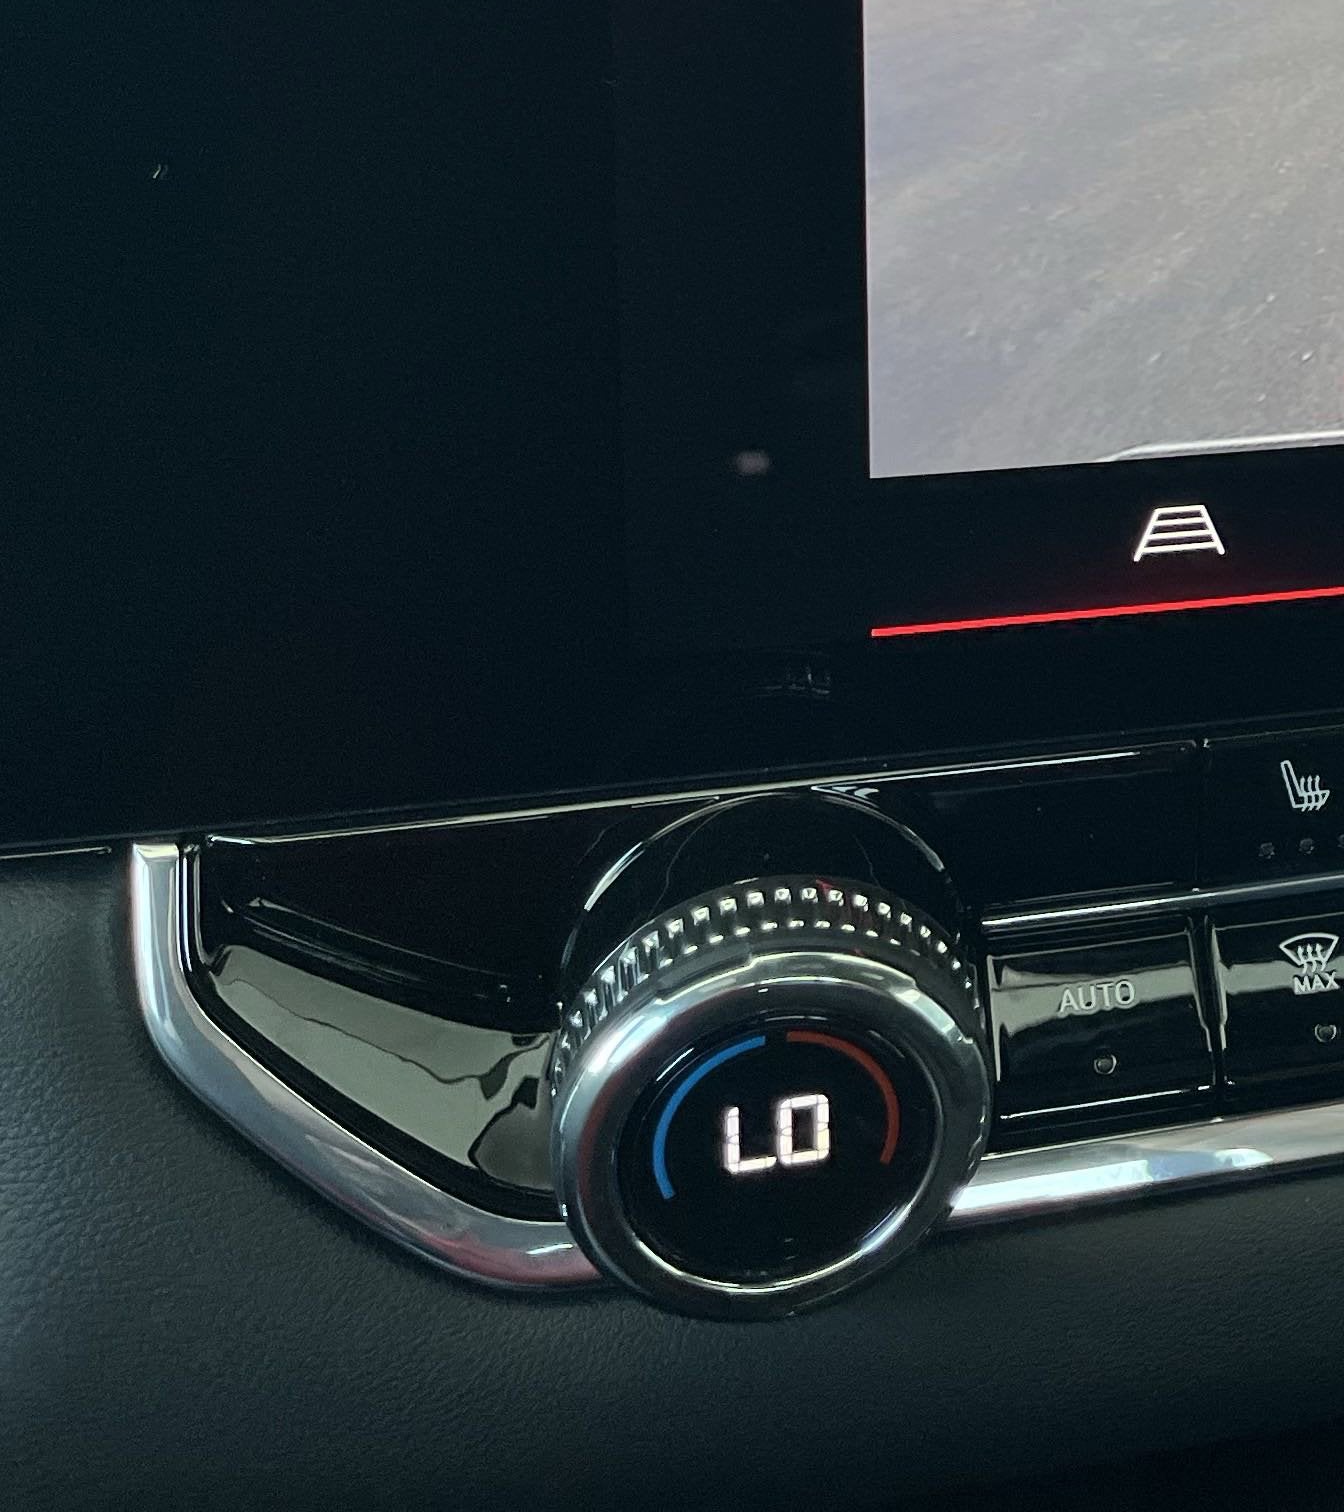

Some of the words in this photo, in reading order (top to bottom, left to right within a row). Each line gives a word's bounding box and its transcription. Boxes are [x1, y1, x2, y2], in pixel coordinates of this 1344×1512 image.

[1057, 978, 1138, 1016] AUTO
[1293, 969, 1340, 995] MAX
[721, 1091, 833, 1176] LO
